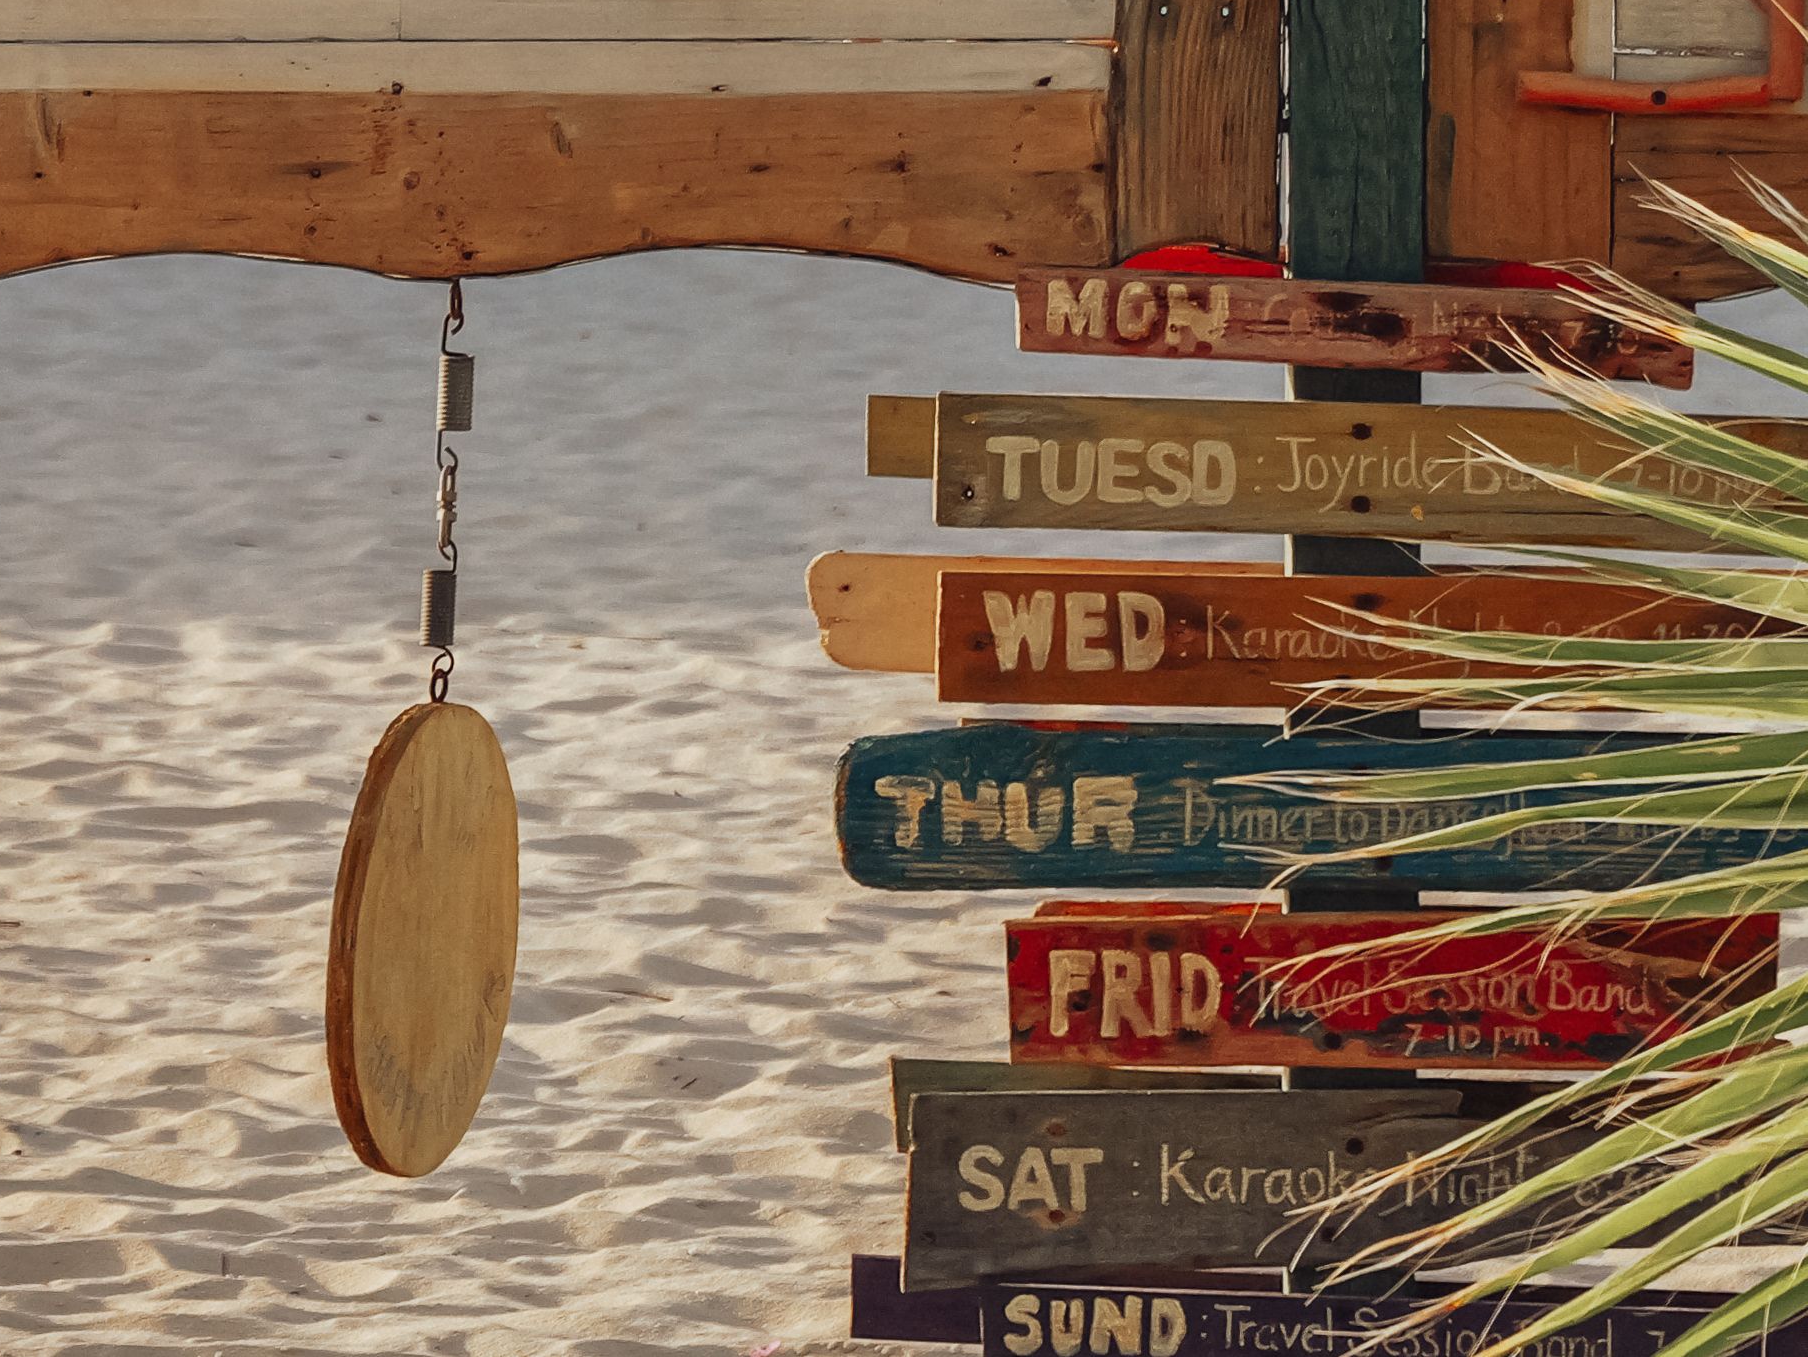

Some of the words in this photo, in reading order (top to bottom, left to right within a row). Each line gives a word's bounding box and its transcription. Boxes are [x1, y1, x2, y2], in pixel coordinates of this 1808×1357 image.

[1046, 278, 1230, 344] MON
[985, 435, 1238, 507] TUESD
[1275, 431, 1434, 514] Joyride
[982, 590, 1165, 674] WED
[1205, 603, 1391, 661] Karaoke
[874, 775, 1138, 855] THUR
[1183, 786, 1323, 847] Dinner
[1048, 949, 1222, 1039] FRID
[1243, 956, 1371, 1021] Travel
[1549, 961, 1656, 1016] Band
[957, 1145, 1104, 1215] SAT
[1003, 1293, 1186, 1357] SUND
[1213, 1303, 1334, 1353] Travel
